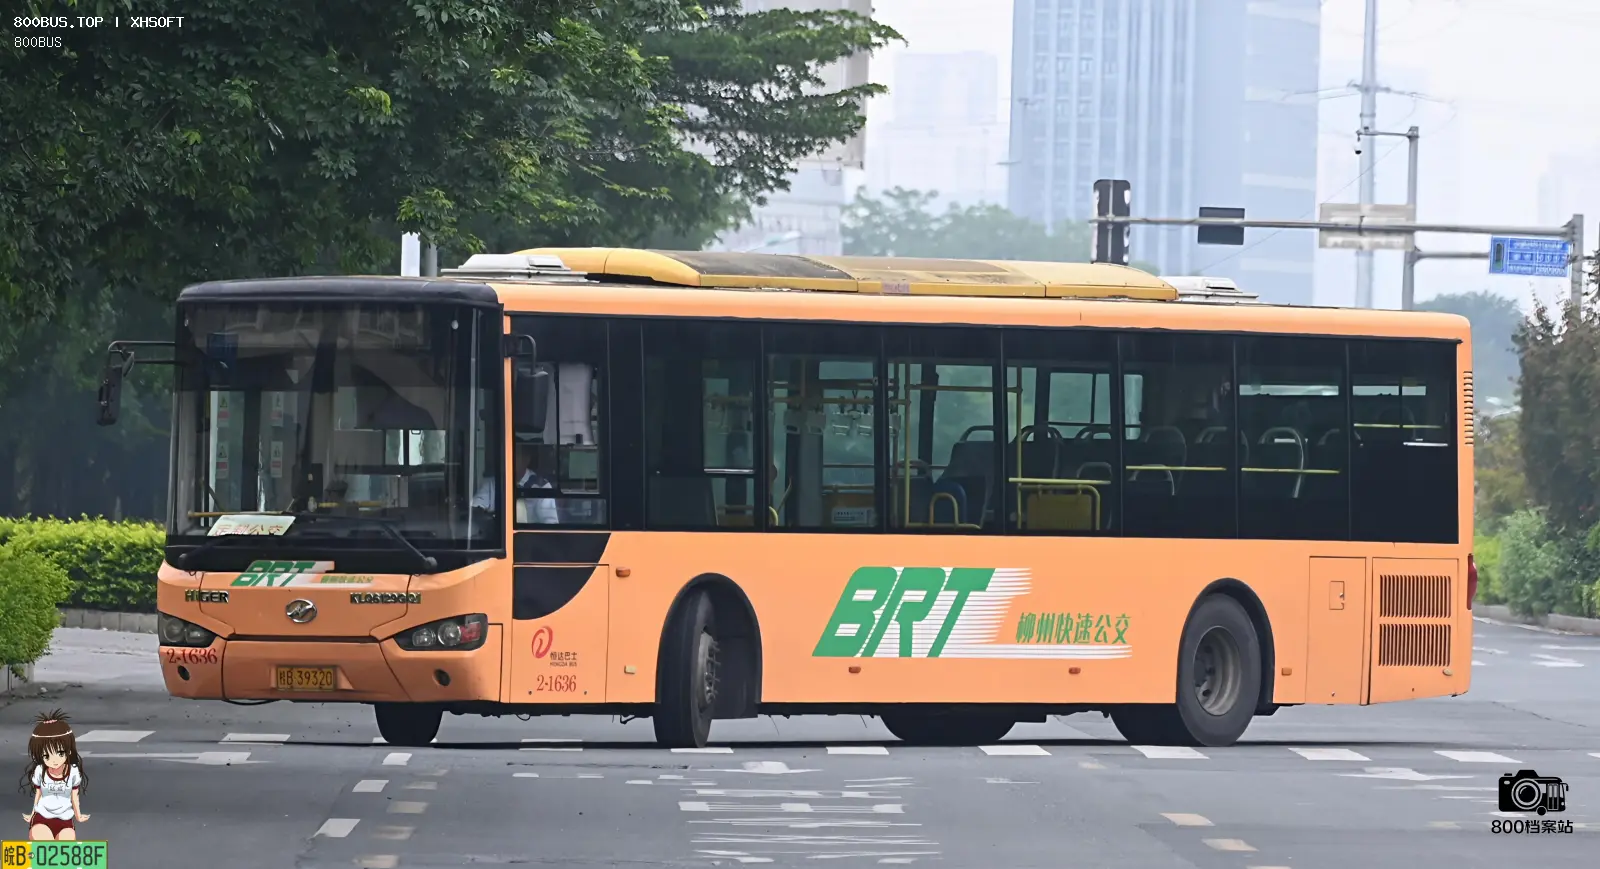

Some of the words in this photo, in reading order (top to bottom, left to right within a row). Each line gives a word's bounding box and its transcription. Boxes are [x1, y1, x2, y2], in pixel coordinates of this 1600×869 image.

[184, 589, 229, 604] HIGER
[812, 566, 996, 658] BRT
[1015, 612, 1131, 645] 柳州快速公交
[550, 651, 577, 661] 恒达巴士
